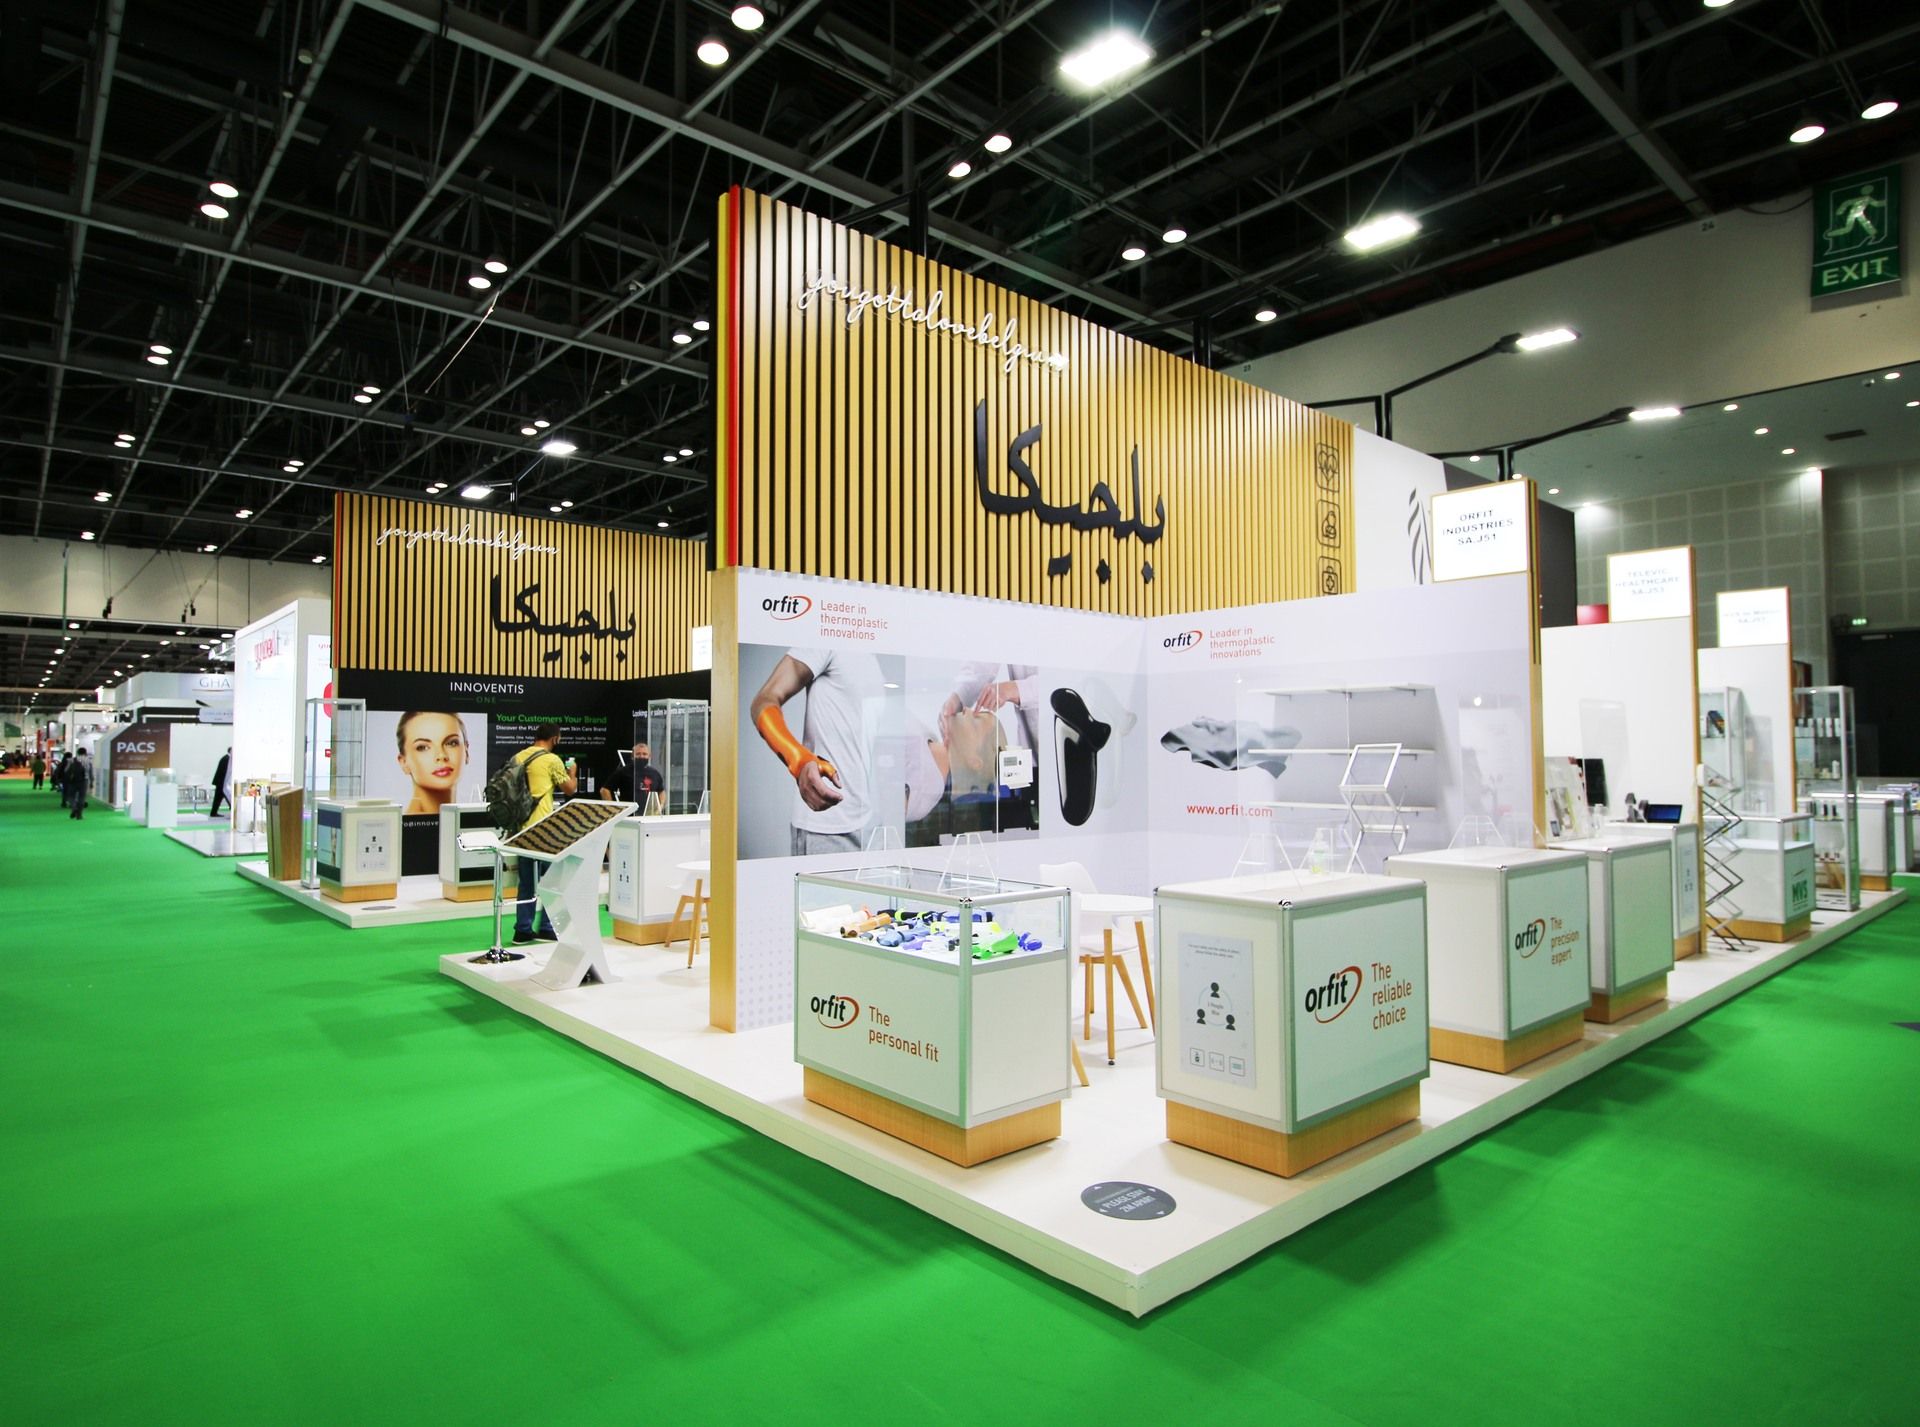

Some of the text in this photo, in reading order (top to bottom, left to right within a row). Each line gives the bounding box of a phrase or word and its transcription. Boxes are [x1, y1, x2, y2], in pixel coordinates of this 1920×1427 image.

[1821, 256, 1889, 287] EXIT
[975, 398, 1166, 585] بلجيكا
[1459, 509, 1493, 522] ORFIT
[1442, 518, 1513, 536] INDUSTRIES
[762, 595, 799, 614] orfit
[820, 600, 867, 614] Leader in
[490, 574, 637, 665] بلجيكا
[820, 613, 888, 630] thermoplastic
[820, 625, 876, 641] innovations
[1163, 633, 1192, 648] orfit
[1209, 627, 1253, 639] Leader in
[1209, 635, 1275, 649] thermoplastic
[1210, 647, 1262, 659] innovations
[450, 681, 524, 694] INNOVENTIS
[475, 696, 497, 704] ONE
[496, 713, 607, 724] Your Customers Your Brand
[116, 741, 156, 753] PACS
[1186, 804, 1273, 818] www.orfit.com
[1550, 916, 1562, 931] The
[1514, 923, 1538, 951] orfit
[1551, 930, 1580, 952] precision
[1551, 948, 1572, 966] expert
[1371, 962, 1392, 982] The
[1304, 972, 1349, 1013] orfit
[1372, 979, 1413, 1007] reliable
[810, 994, 846, 1022] orfit
[868, 1005, 891, 1027] The
[1373, 1005, 1407, 1030] choice
[868, 1029, 939, 1063] personal fit
